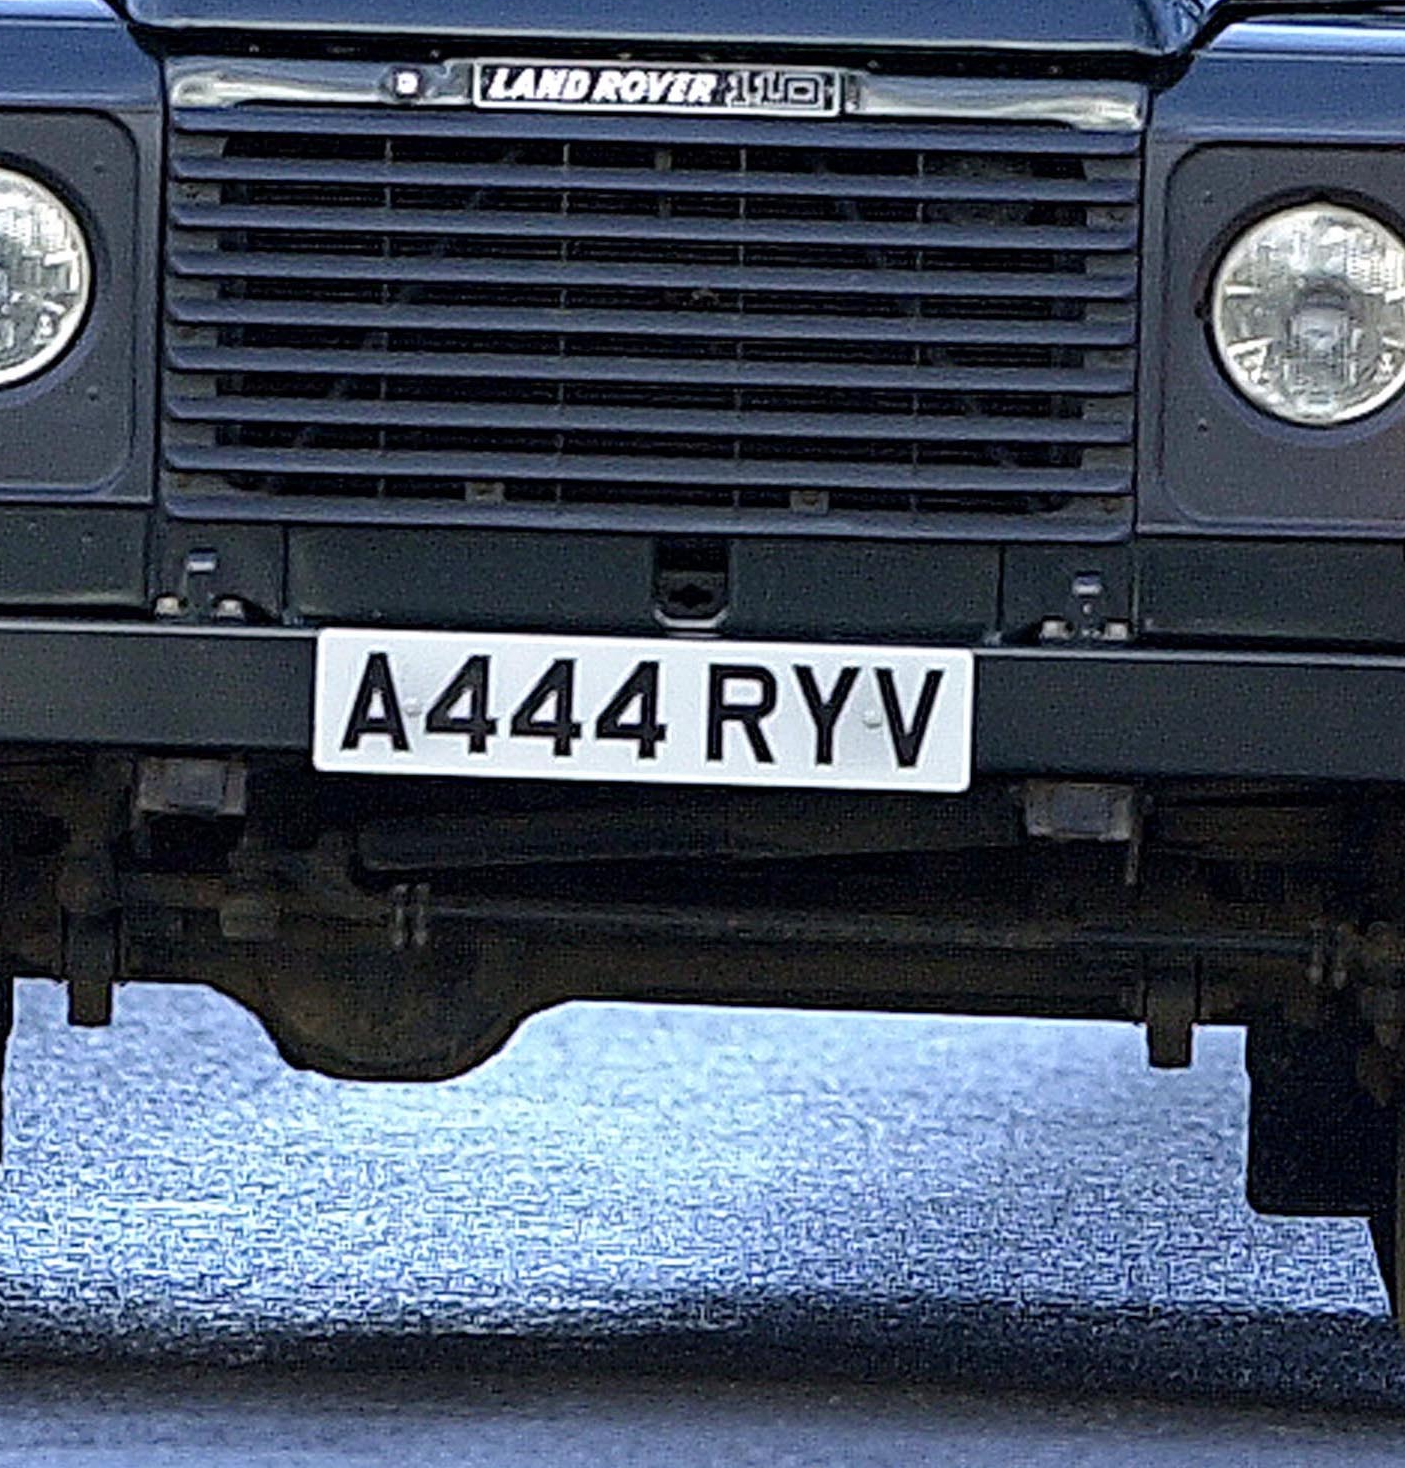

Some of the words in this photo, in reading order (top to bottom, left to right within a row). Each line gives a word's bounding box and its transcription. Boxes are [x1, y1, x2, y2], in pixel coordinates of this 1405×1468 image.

[488, 67, 592, 101] LAND
[594, 69, 717, 104] ROVER
[726, 70, 823, 109] 110
[340, 651, 666, 759] A444
[707, 664, 945, 768] RYV
